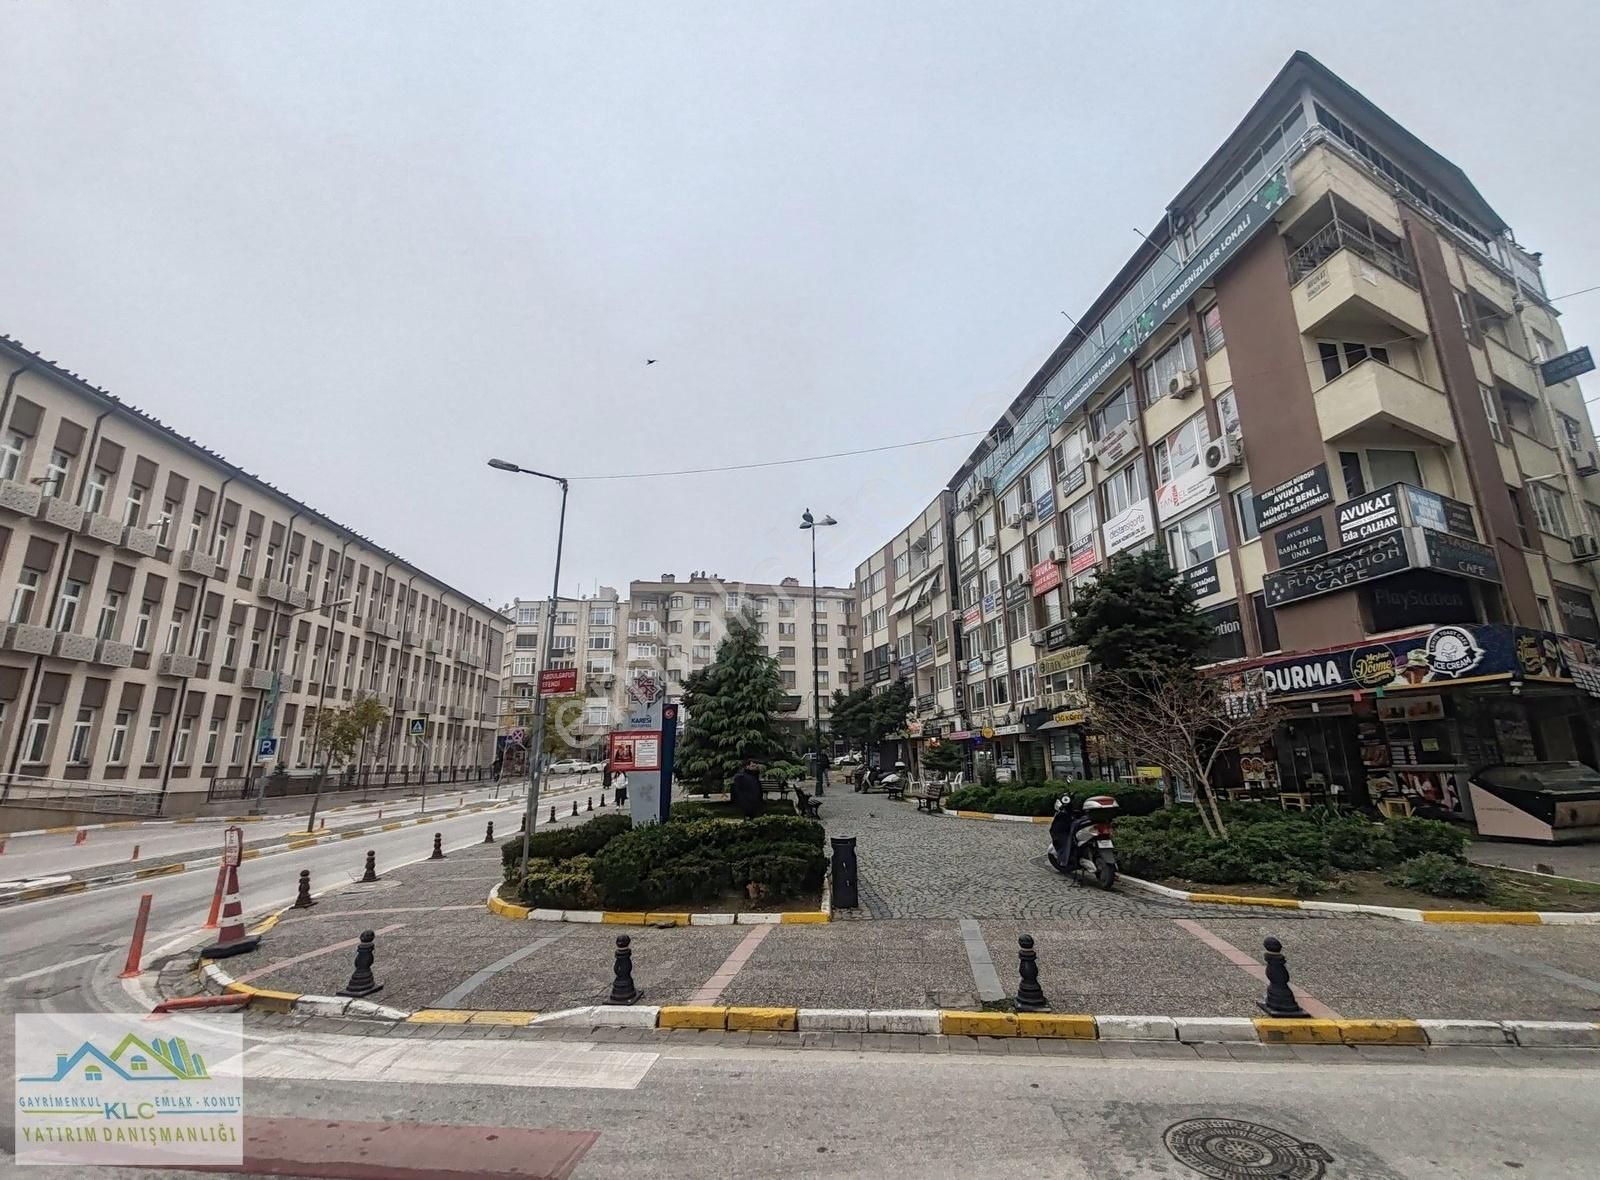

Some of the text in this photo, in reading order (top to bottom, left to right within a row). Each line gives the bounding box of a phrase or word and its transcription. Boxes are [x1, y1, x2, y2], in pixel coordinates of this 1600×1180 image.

[1162, 213, 1251, 310] KARADENİZLİLER LOKALİ
[1263, 484, 1321, 519] MÜMTAZ BENLİ
[1273, 482, 1305, 504] AVUKAT
[1259, 511, 1288, 529] ARABULUCU
[1290, 492, 1330, 515] UZLAŞTIRMACI
[1340, 493, 1391, 523] AVUKAT
[1286, 525, 1310, 540] AVUKAT
[1342, 530, 1358, 543] Eda
[1360, 515, 1398, 538] ÇALHAN
[1278, 535, 1323, 556] RABİA ZEHRA
[1290, 547, 1311, 560] ÜNAL
[1287, 547, 1401, 589] PLAYSTATION
[1458, 561, 1487, 576] CAFE
[1315, 569, 1369, 592] CAFE
[1374, 588, 1464, 610] PlayStation
[1354, 659, 1392, 679] Dövme
[1433, 656, 1472, 670] ICE CREAM
[1264, 660, 1343, 693] DURMA
[631, 714, 652, 723] KARESİ
[261, 740, 271, 753] P
